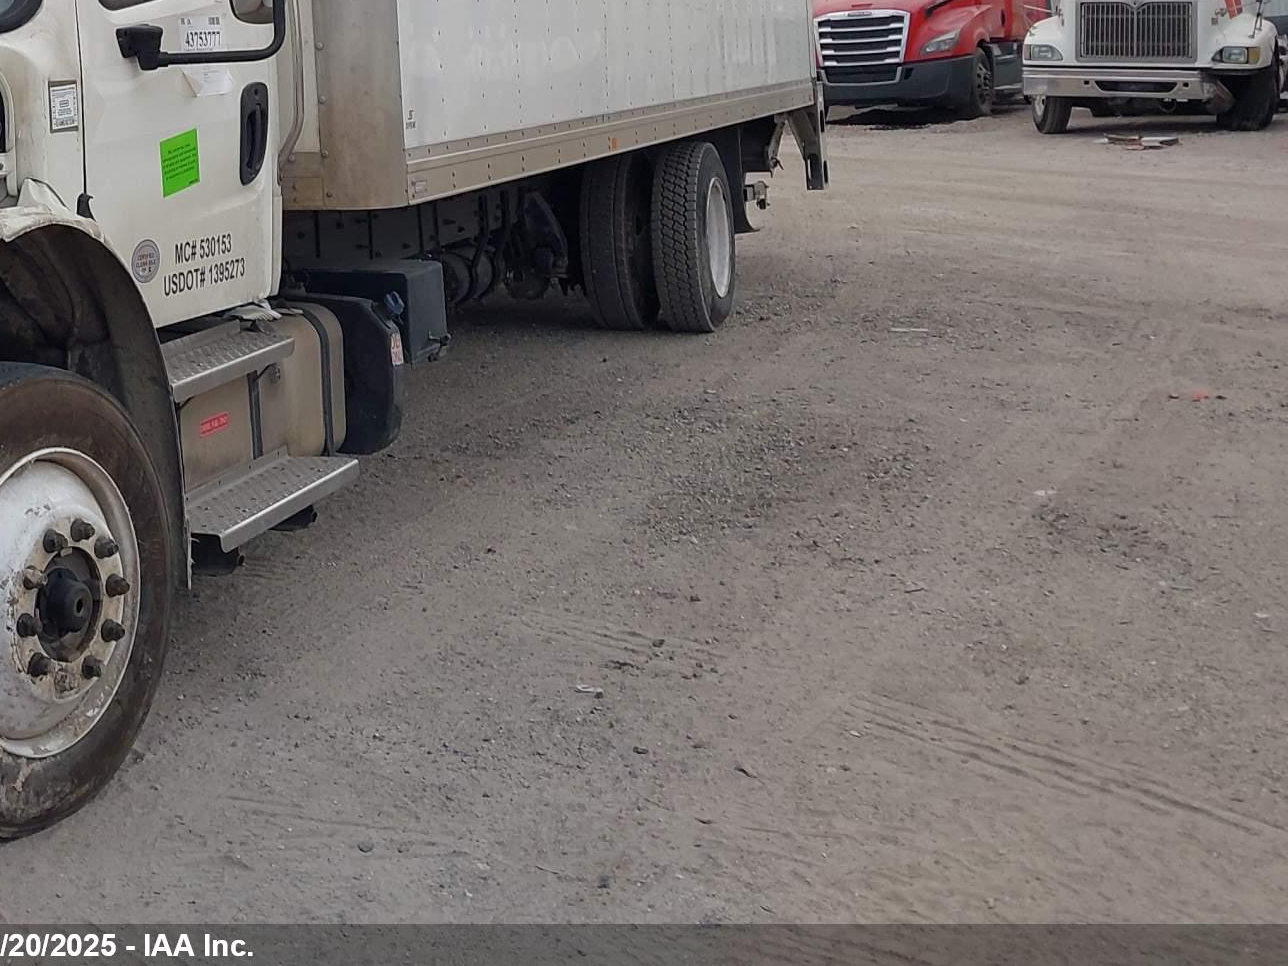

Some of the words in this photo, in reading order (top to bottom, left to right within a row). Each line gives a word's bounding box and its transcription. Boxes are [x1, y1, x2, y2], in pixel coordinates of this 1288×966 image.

[185, 30, 221, 48] 43753777
[175, 240, 197, 265] MC#
[199, 233, 232, 259] 530153
[163, 265, 206, 296] USDOT#
[208, 257, 245, 285] 1395273
